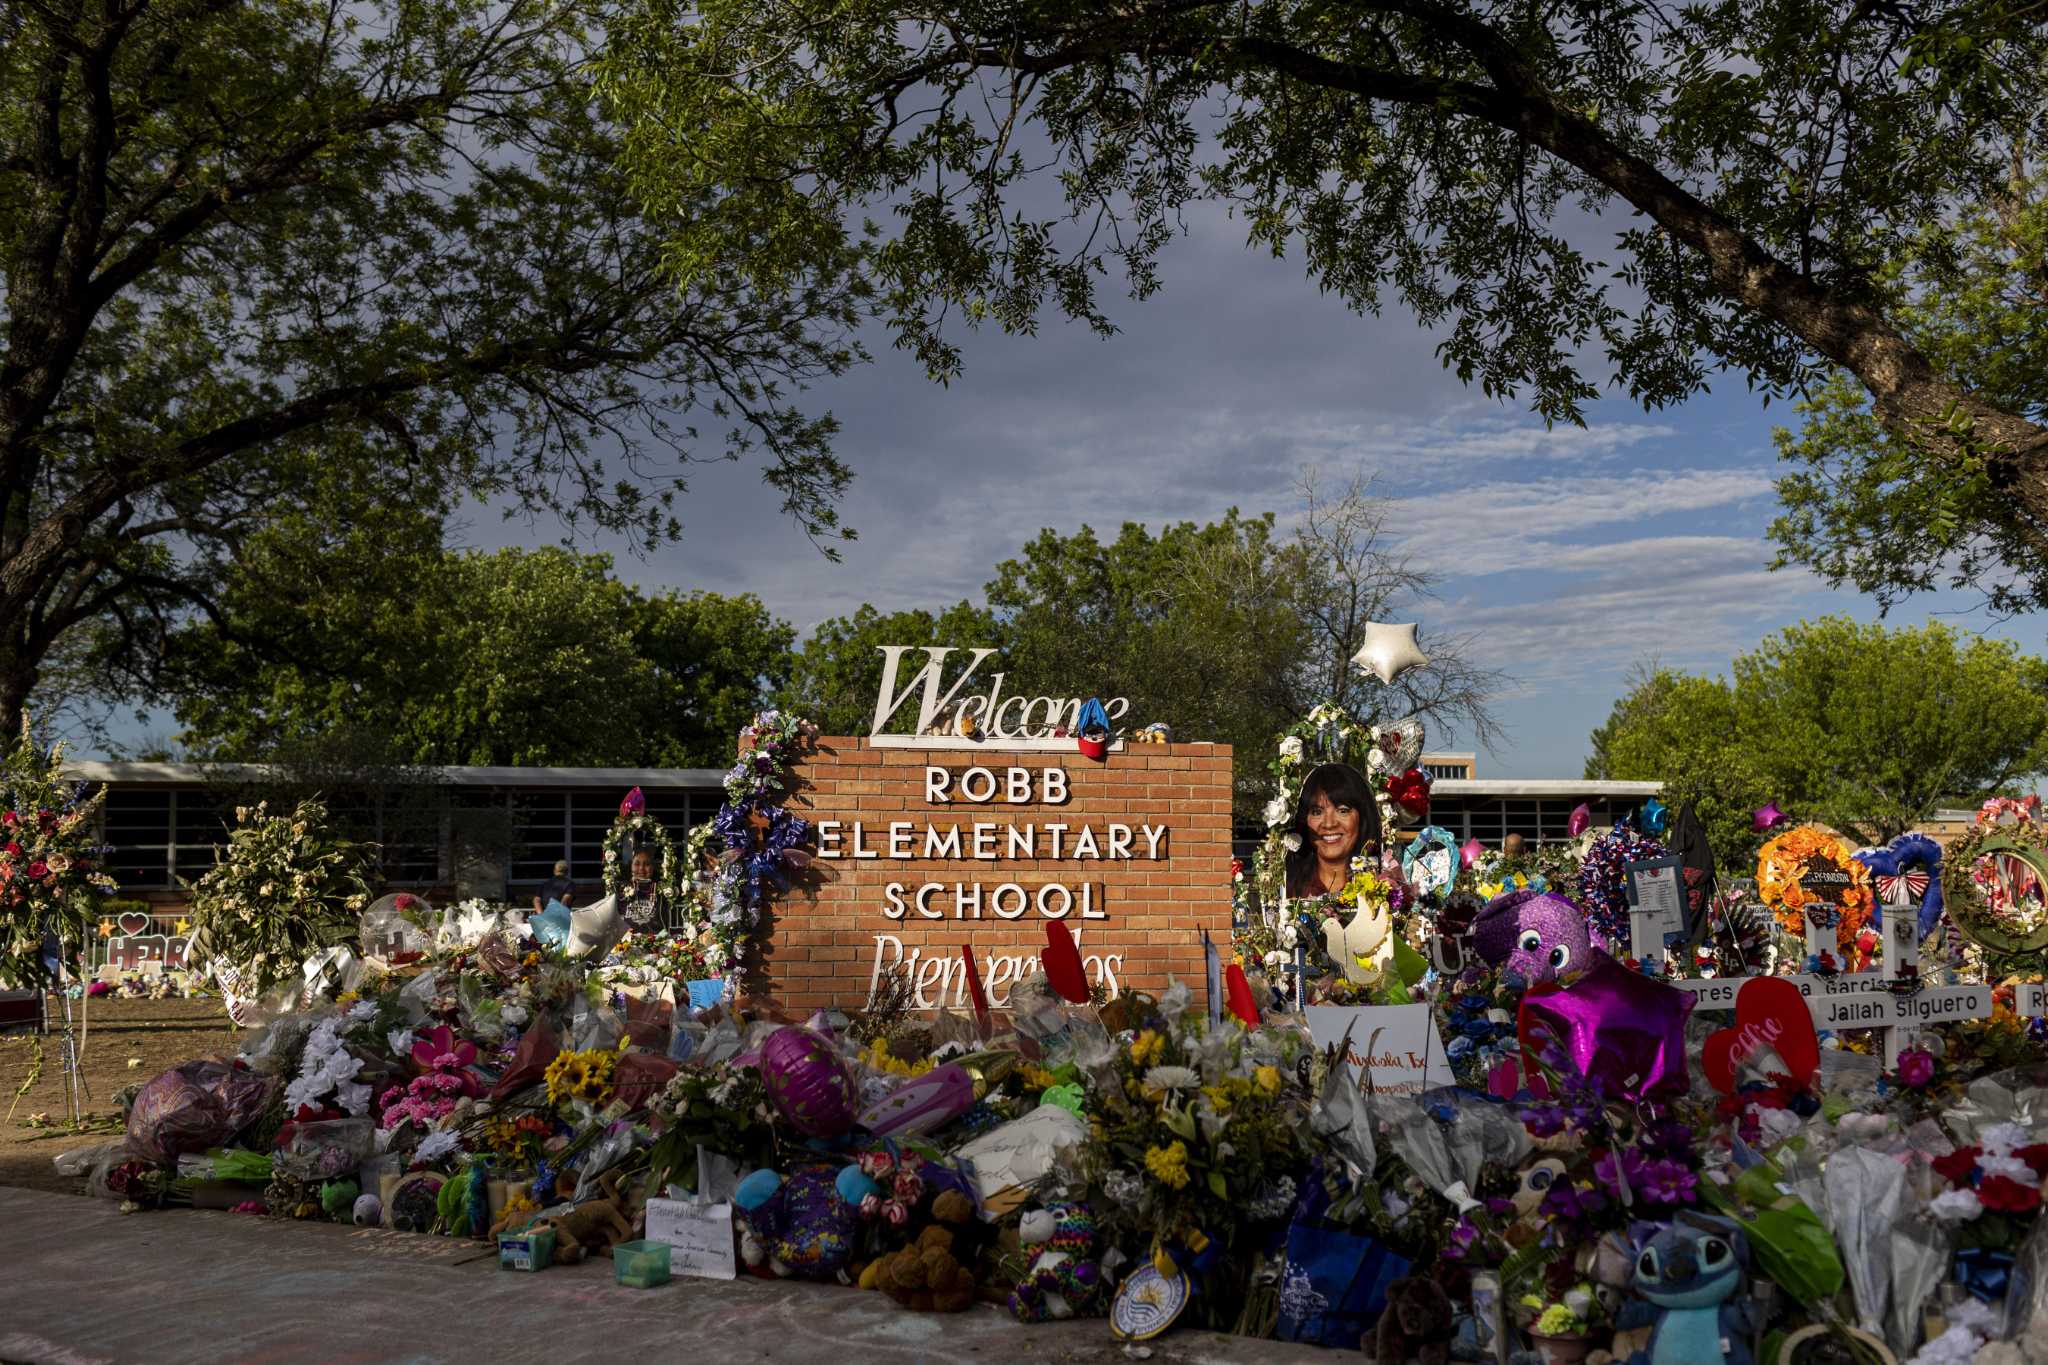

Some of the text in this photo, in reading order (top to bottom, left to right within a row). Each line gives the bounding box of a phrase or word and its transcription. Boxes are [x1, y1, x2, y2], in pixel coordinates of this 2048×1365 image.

[871, 645, 1130, 739] Welcome
[925, 766, 1068, 803] ROBB
[817, 821, 1167, 860] ELEMENTARY
[884, 882, 1105, 919] SCHOOL
[1825, 978, 1889, 995] Garci
[1828, 994, 1978, 1022] Jailah Silguero
